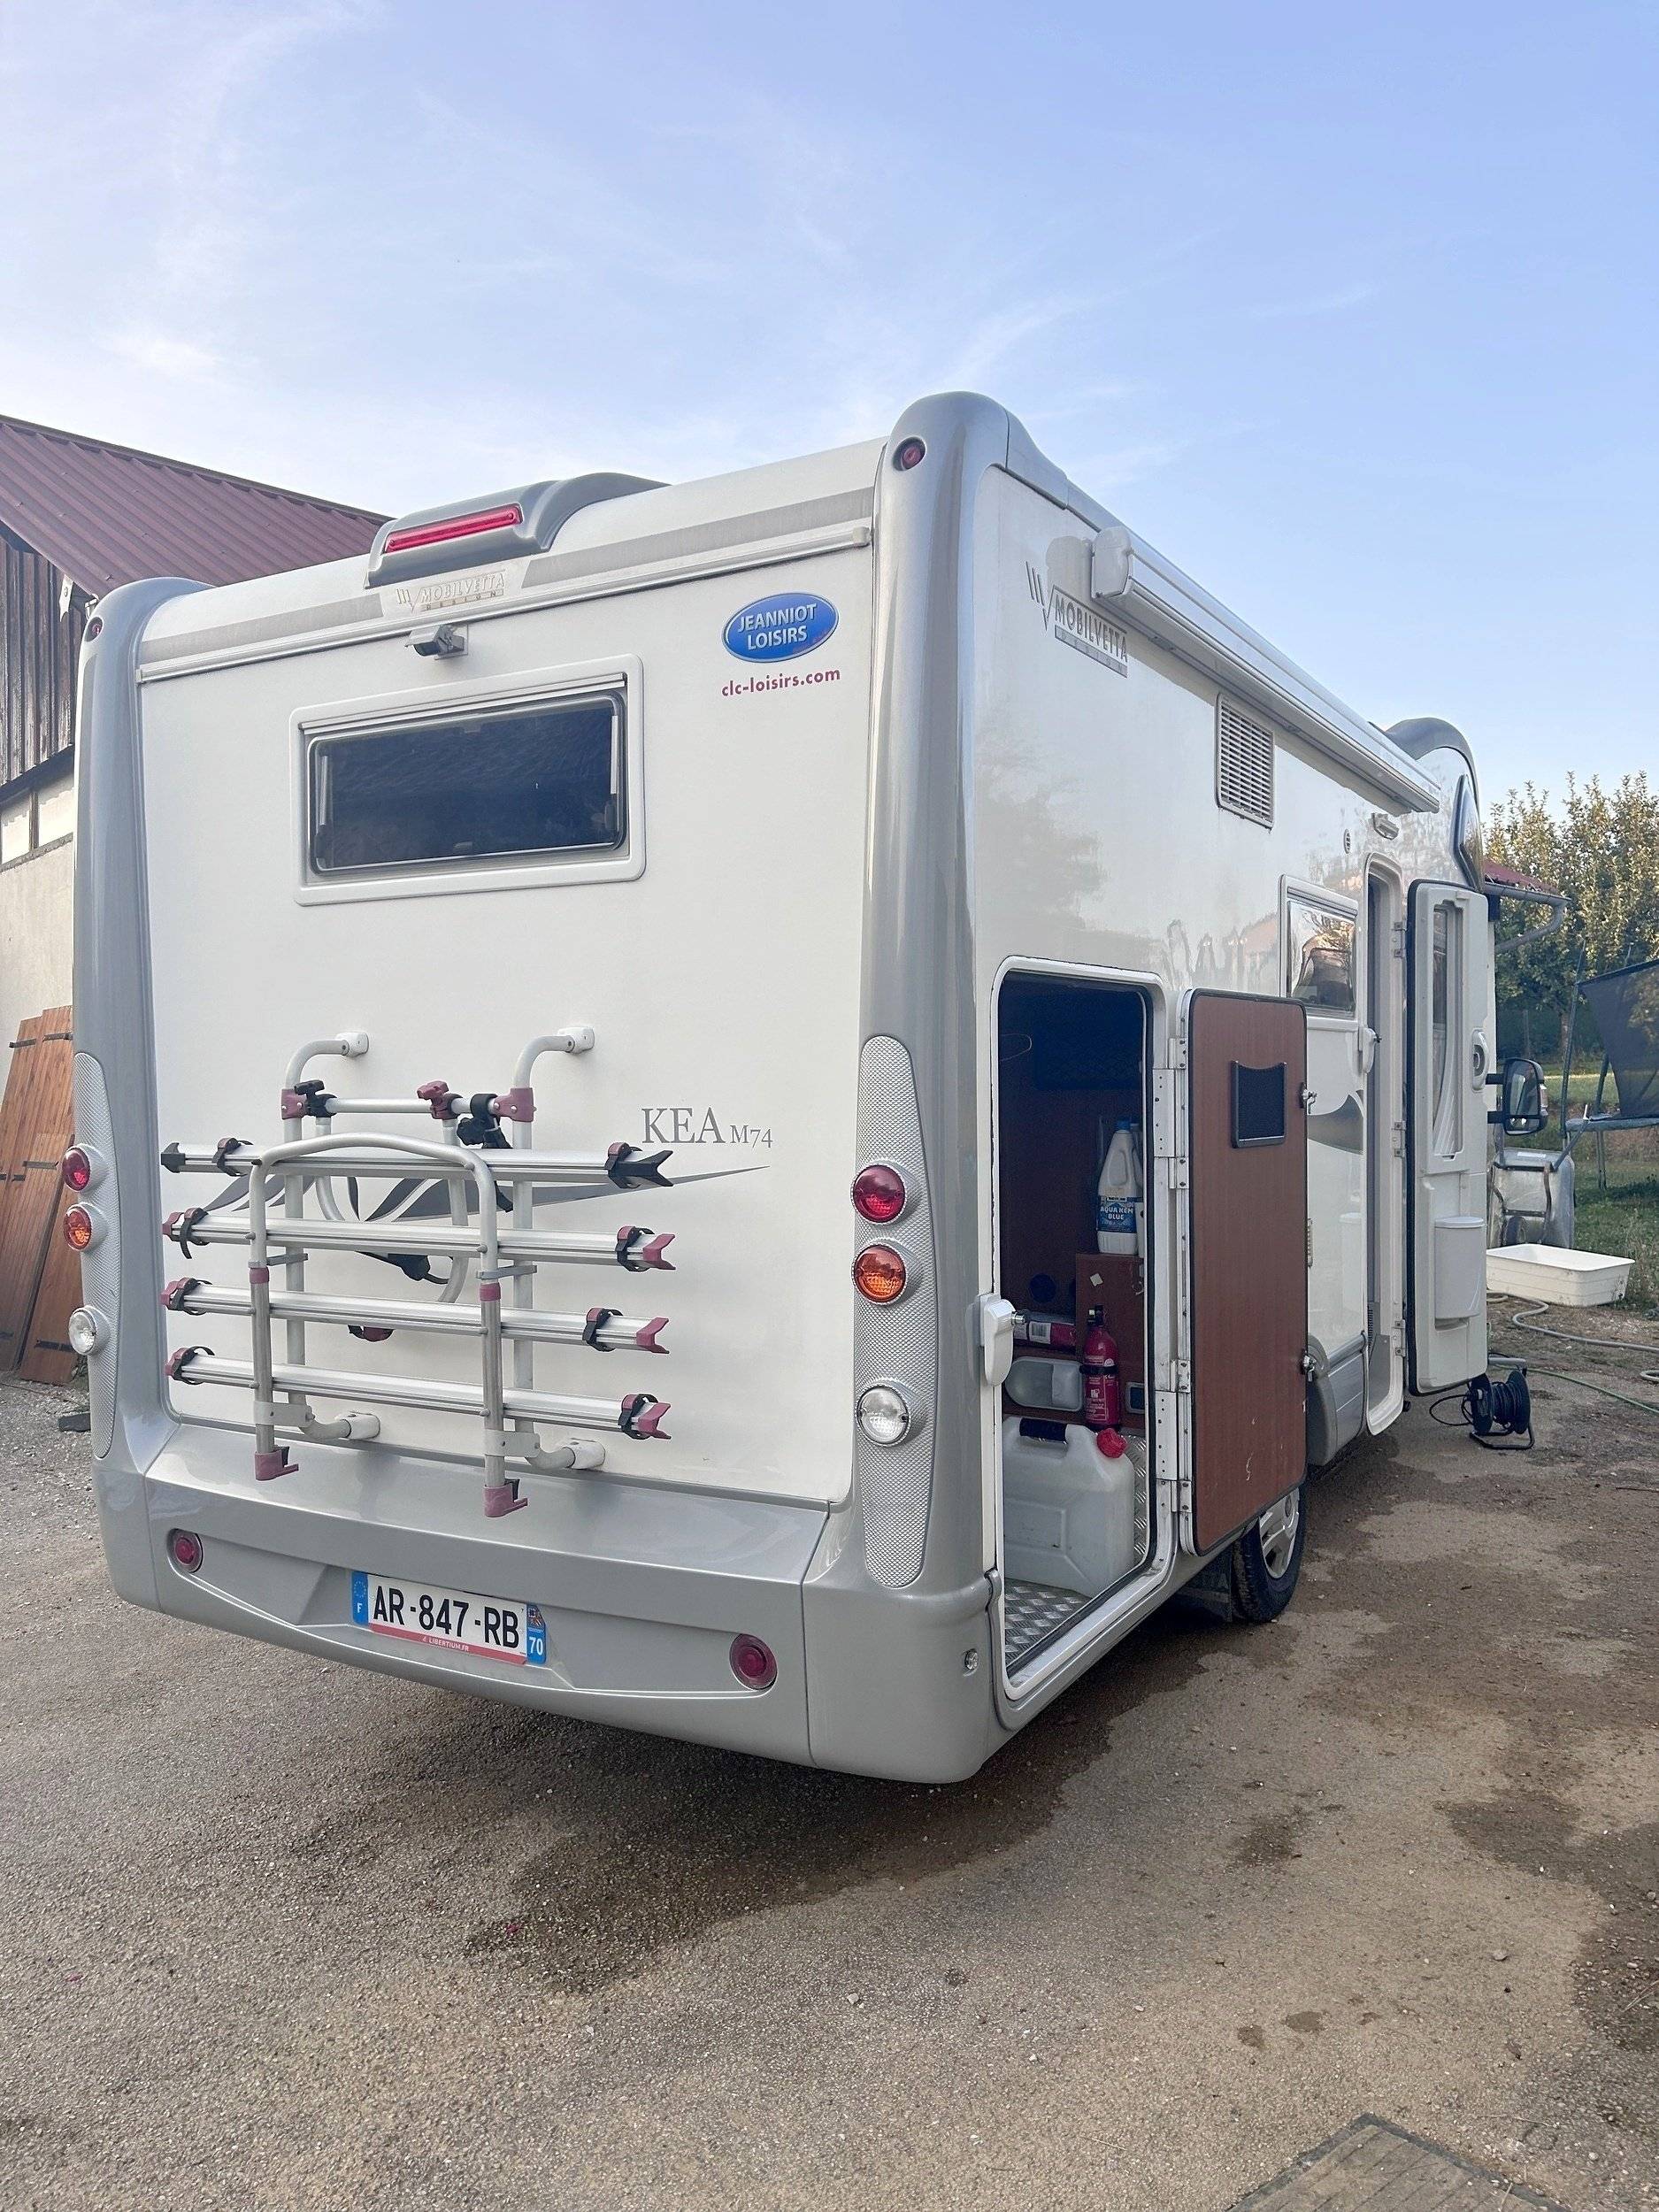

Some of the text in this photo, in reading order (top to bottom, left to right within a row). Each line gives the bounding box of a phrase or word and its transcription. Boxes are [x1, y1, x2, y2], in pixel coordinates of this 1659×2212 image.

[420, 572, 505, 603] MOBILVETTA
[738, 603, 818, 633] JEANNIOT
[1055, 594, 1128, 663] MOBILVETTA
[748, 626, 809, 650] LOISIRS
[722, 669, 841, 696] clc-loisirs.com
[641, 1107, 773, 1148] KEA M74
[357, 1602, 363, 1614] F
[373, 1586, 519, 1648] AR-847-RB
[428, 1638, 469, 1652] LIBERTIUM.FR
[529, 1636, 543, 1655] 70
